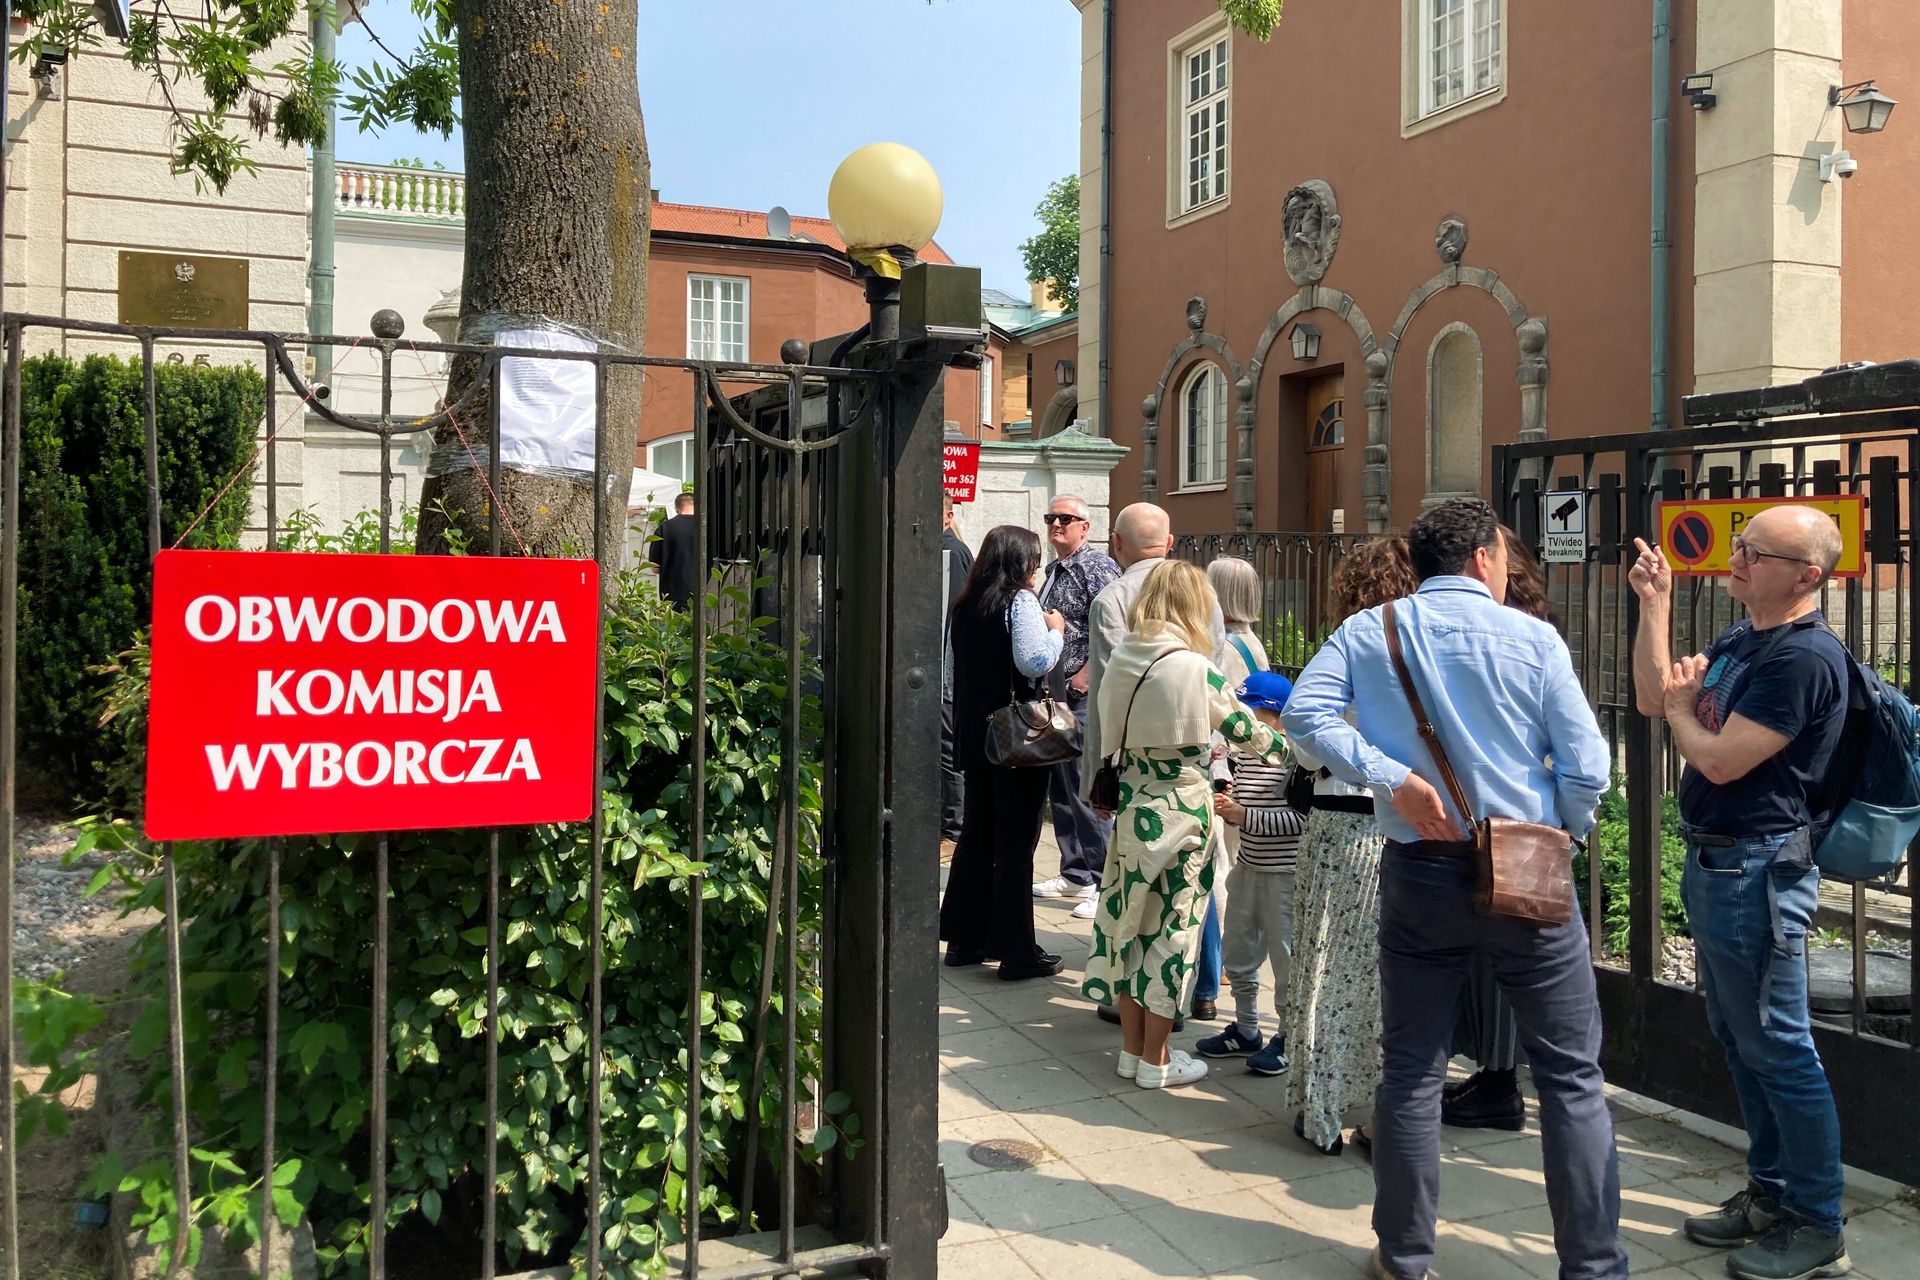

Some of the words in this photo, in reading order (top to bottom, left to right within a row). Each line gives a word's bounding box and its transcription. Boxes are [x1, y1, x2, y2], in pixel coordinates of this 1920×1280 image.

[959, 474, 975, 484] 362
[1548, 537, 1582, 546] TV/video
[1548, 548, 1582, 558] bevakning
[184, 595, 567, 643] OBWODOWA
[256, 669, 502, 723] KOMISJA
[204, 738, 542, 791] WYBORCZA
